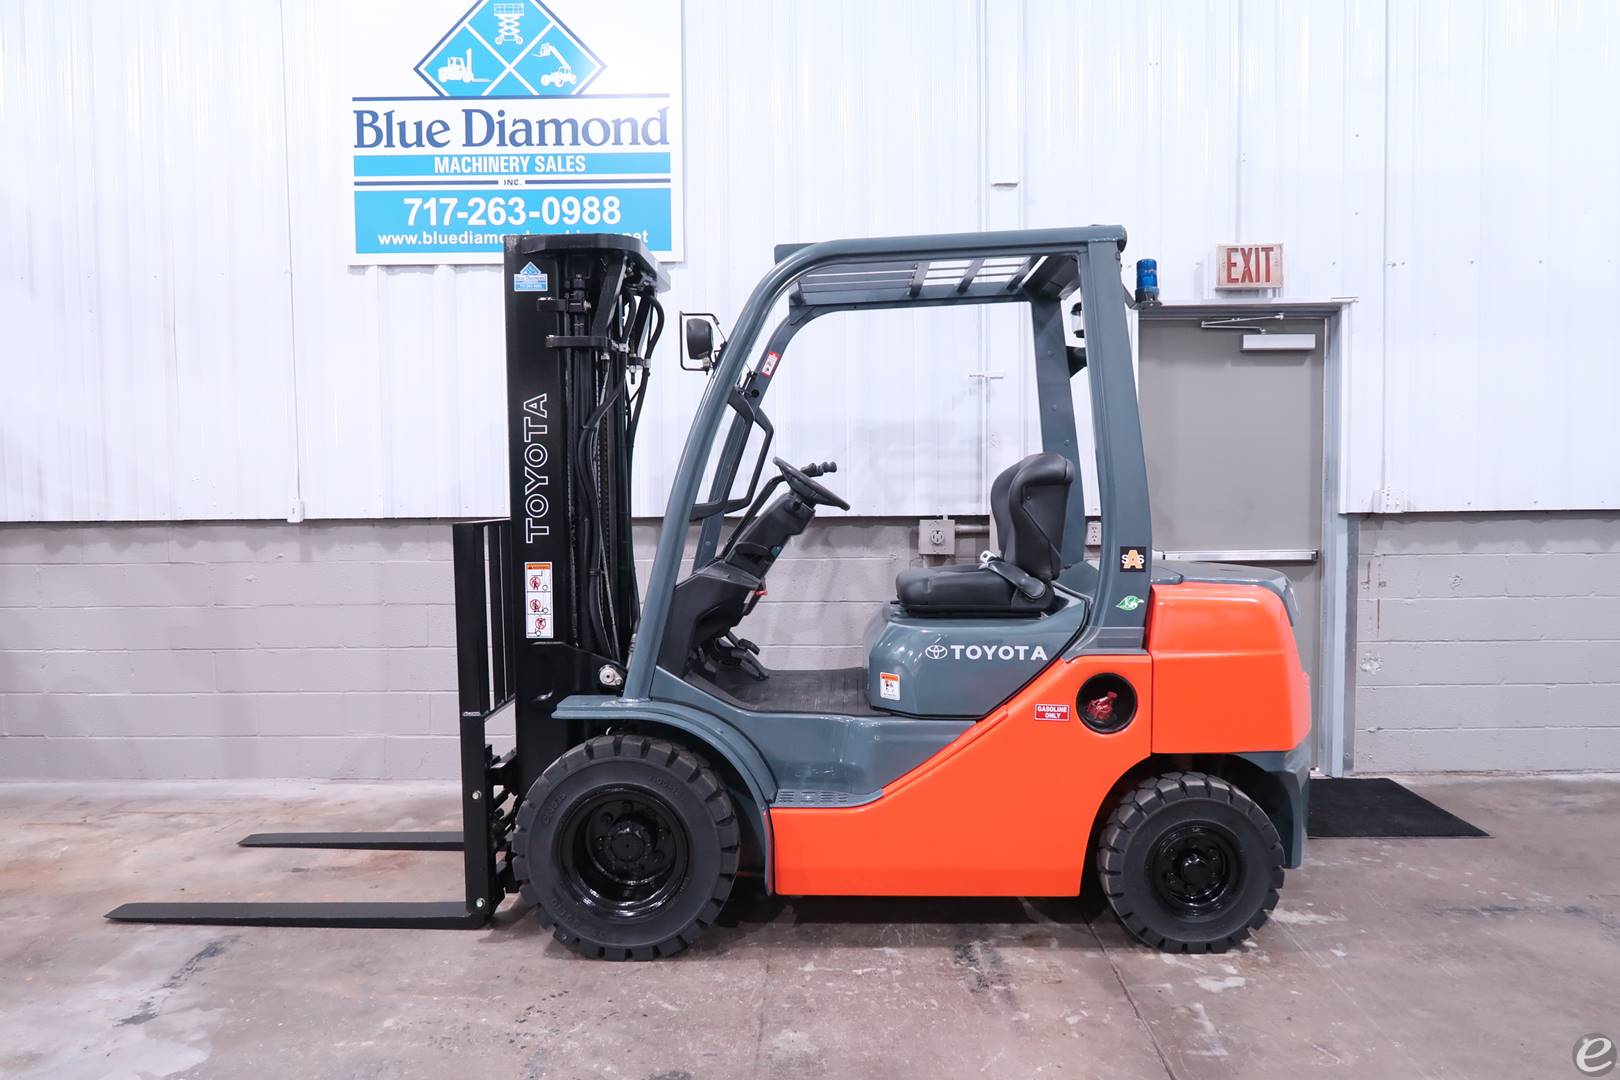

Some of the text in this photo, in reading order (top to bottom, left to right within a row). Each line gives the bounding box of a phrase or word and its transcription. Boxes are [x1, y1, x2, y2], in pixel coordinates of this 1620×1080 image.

[353, 106, 670, 149] Blue Diamond
[434, 155, 586, 174] MACHINERY SALES
[403, 196, 622, 226] 717-263-0988
[1226, 247, 1274, 283] EXIT
[523, 393, 550, 544] TOYOTA
[950, 644, 1048, 660] TOYOTA
[1037, 705, 1068, 713] GASOLINE
[1044, 711, 1061, 719] ONLY
